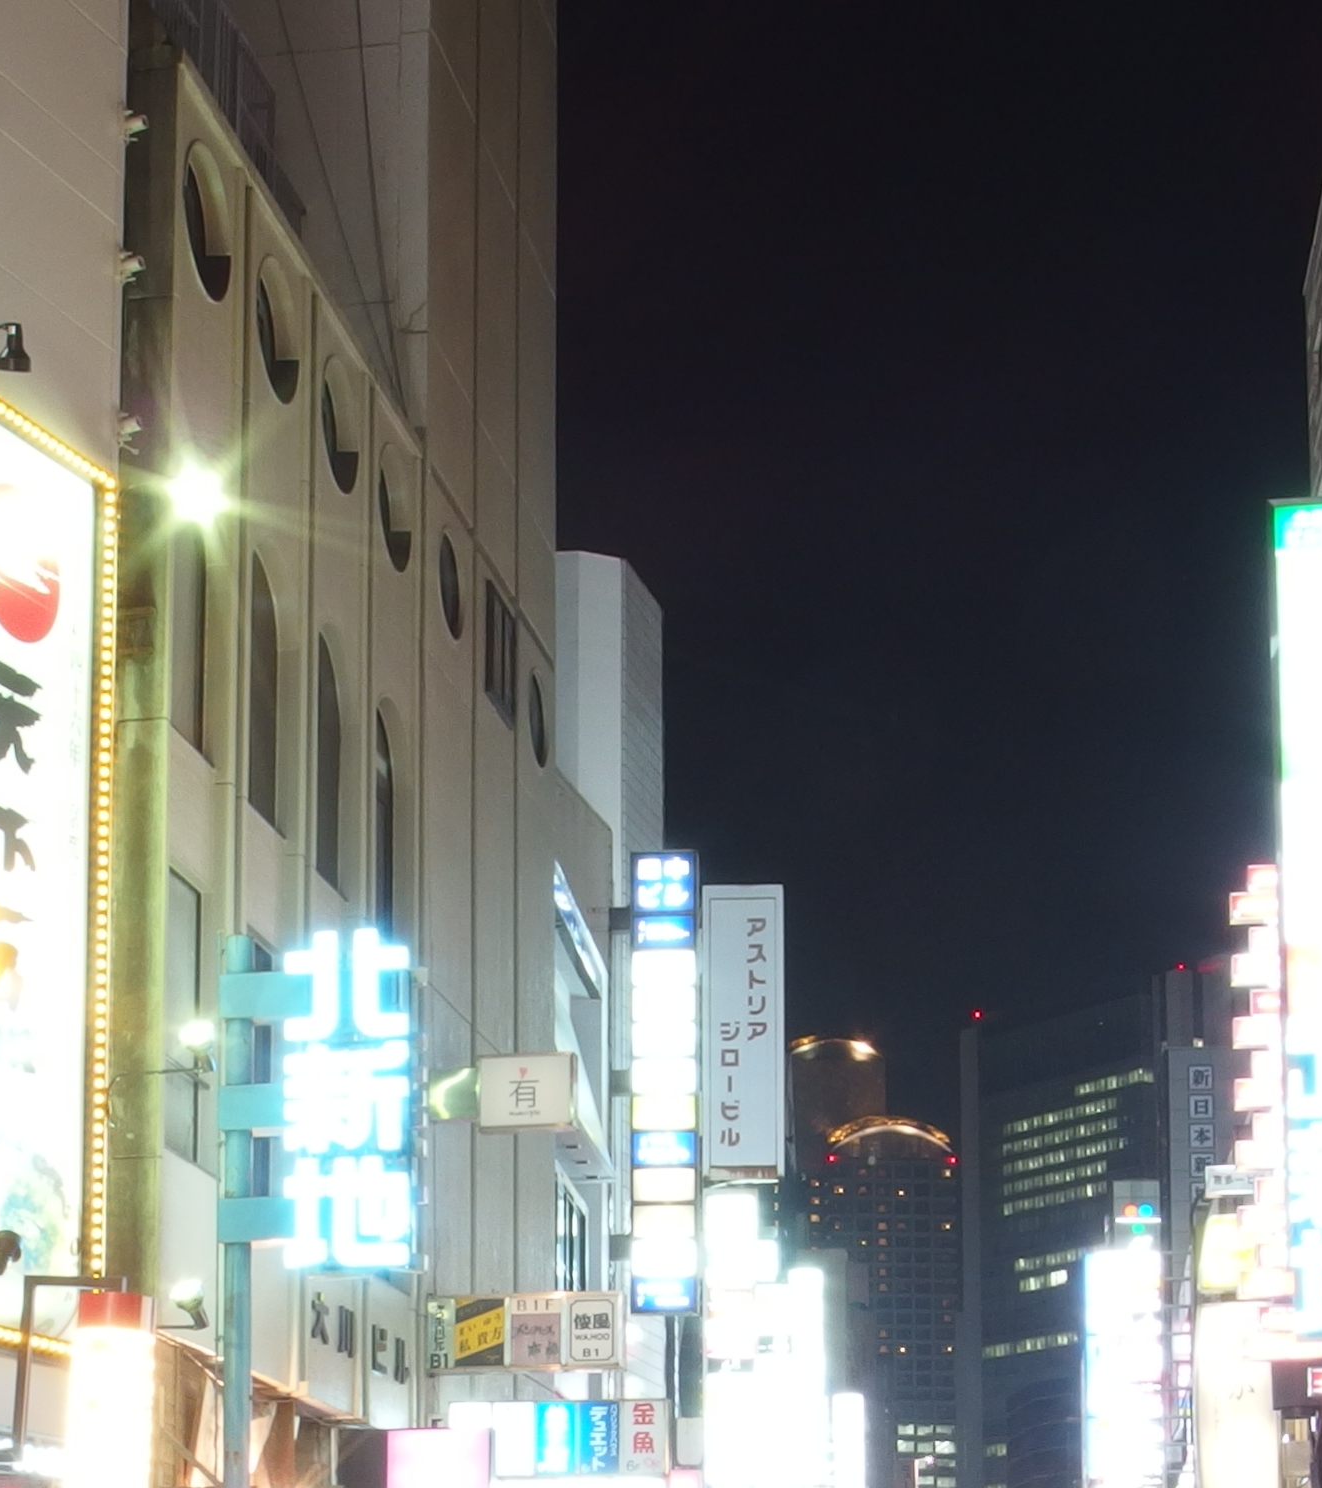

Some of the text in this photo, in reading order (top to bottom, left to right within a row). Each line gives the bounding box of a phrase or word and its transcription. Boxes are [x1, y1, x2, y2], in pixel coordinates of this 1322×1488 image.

[746, 917, 767, 1040] アストリア
[283, 927, 412, 1270] 北新地
[509, 1079, 540, 1108] 有
[719, 1021, 741, 1147] ジロービル
[431, 1354, 449, 1369] B1
[632, 1402, 655, 1455] 金魚
